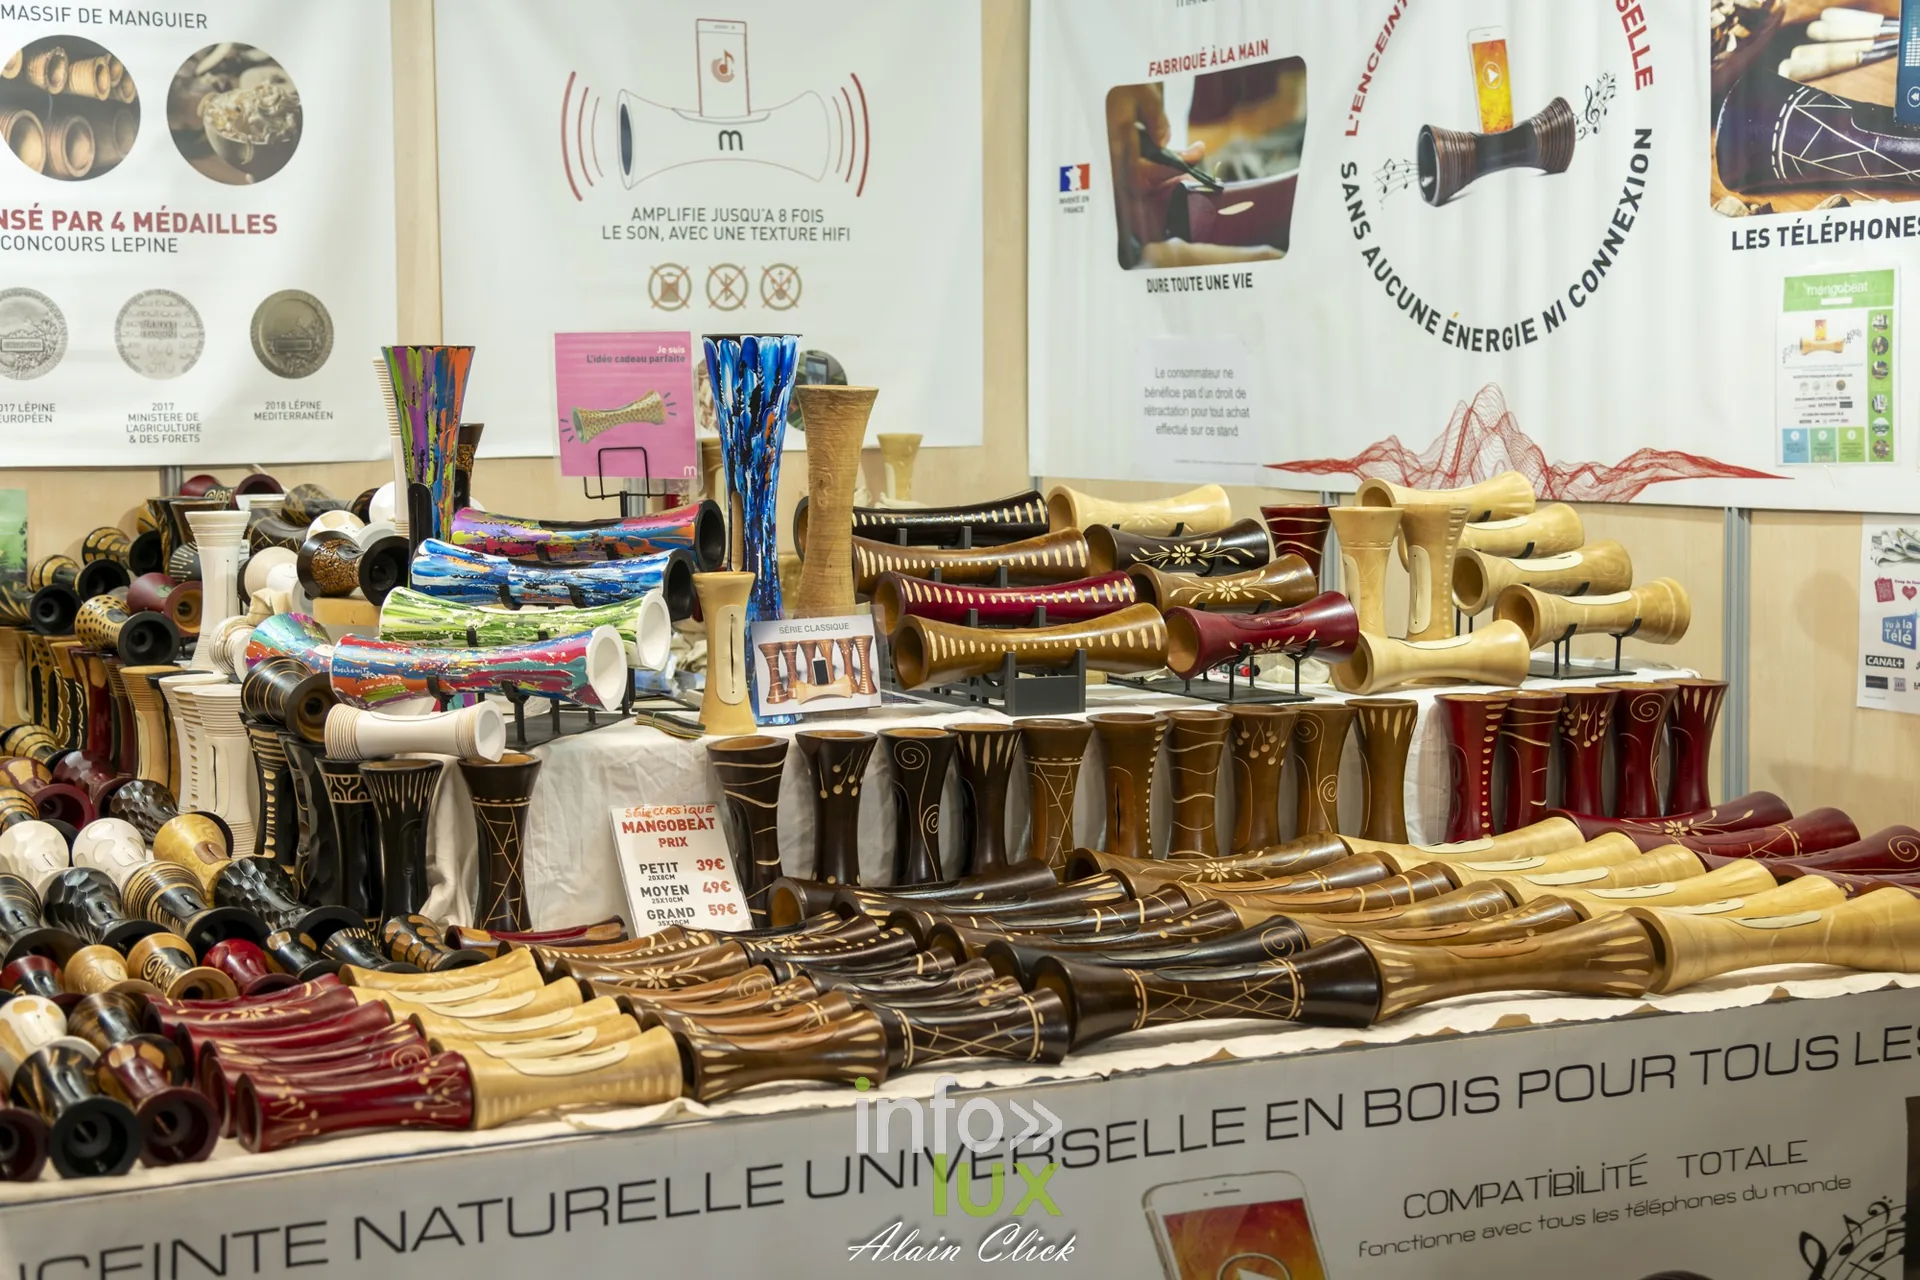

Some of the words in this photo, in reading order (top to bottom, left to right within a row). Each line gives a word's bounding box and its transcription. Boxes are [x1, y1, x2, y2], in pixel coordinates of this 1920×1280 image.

[1, 3, 71, 22] MASSIF
[78, 8, 103, 24] DE
[109, 9, 208, 29] MANGUIER
[1148, 46, 1207, 77] FABRIQUÉ
[1220, 46, 1235, 64] LA
[1238, 38, 1269, 59] MAIN
[719, 130, 743, 151] m
[52, 210, 103, 232] PAR
[111, 211, 125, 231] 4
[134, 205, 278, 234] MÉDAILLES
[631, 207, 706, 222] AMPLIFIE
[778, 209, 787, 222] 8
[791, 209, 824, 223] FOIS
[602, 225, 622, 240] LE
[626, 225, 664, 242] SON,
[669, 226, 708, 240] AVEC
[714, 226, 746, 241] UNE
[750, 227, 818, 241] TEXTURE
[822, 227, 850, 242] HIFI
[1341, 162, 1371, 240] SANS
[1362, 247, 1441, 335] AUCUNE
[1442, 312, 1538, 352] ÉNERGIE
[1542, 300, 1567, 333] NI
[1568, 128, 1652, 308] CONNEXION
[1732, 227, 1770, 250] LES
[1, 234, 105, 252] CONCOURS
[112, 237, 178, 252] LEPINE
[1147, 277, 1169, 293] DURE
[1171, 276, 1203, 292] TOUTE
[1206, 274, 1230, 290] UNE
[1233, 272, 1253, 289] VIE
[656, 346, 667, 354] Je
[668, 346, 686, 354] suis
[614, 354, 647, 363] cadeau
[649, 354, 686, 365] parfaite
[1155, 367, 1165, 379] Le
[1167, 367, 1221, 379] consommateur
[1223, 369, 1234, 379] ne
[1182, 389, 1197, 400] pas
[1235, 388, 1247, 399] de
[152, 402, 175, 412] 2017
[265, 401, 286, 411] 2018
[288, 398, 322, 410] LÉPINE
[1191, 408, 1208, 419] pour
[1210, 407, 1225, 418] tout
[128, 413, 183, 422] MINISTERE
[186, 412, 199, 421] DE
[129, 434, 136, 444] &
[139, 434, 159, 444] DES
[1205, 427, 1215, 436] ce
[779, 625, 802, 634] SÉRIE
[804, 622, 850, 633] CLASSIQUE
[1903, 619, 1912, 629] la
[1885, 628, 1912, 645] Télé
[1867, 656, 1903, 667] CANAL+
[621, 817, 716, 834] MANGOBEAT
[658, 836, 689, 848] PRIX
[639, 862, 679, 875] PETIT
[696, 858, 726, 872] 39€
[640, 884, 690, 898] MOYEN
[702, 881, 732, 893] 49€
[646, 907, 696, 920] GRAND
[708, 903, 738, 916] 59€
[354, 1163, 785, 1260] NATURELLE
[805, 1106, 1247, 1199] UNIVERSELLE
[1266, 1093, 1343, 1141] EN
[1364, 1075, 1500, 1128] BOIS
[1518, 1054, 1676, 1109] POUR
[1690, 1035, 1839, 1086] TOUS
[1677, 1139, 1808, 1179] TOTALE
[1358, 1229, 1476, 1258] fonctionne
[1482, 1220, 1532, 1240] avec
[1537, 1212, 1586, 1231] tous
[1592, 1207, 1619, 1225] les
[1625, 1190, 1737, 1218] téléphones
[1742, 1184, 1768, 1201] du
[1773, 1175, 1851, 1198] monde
